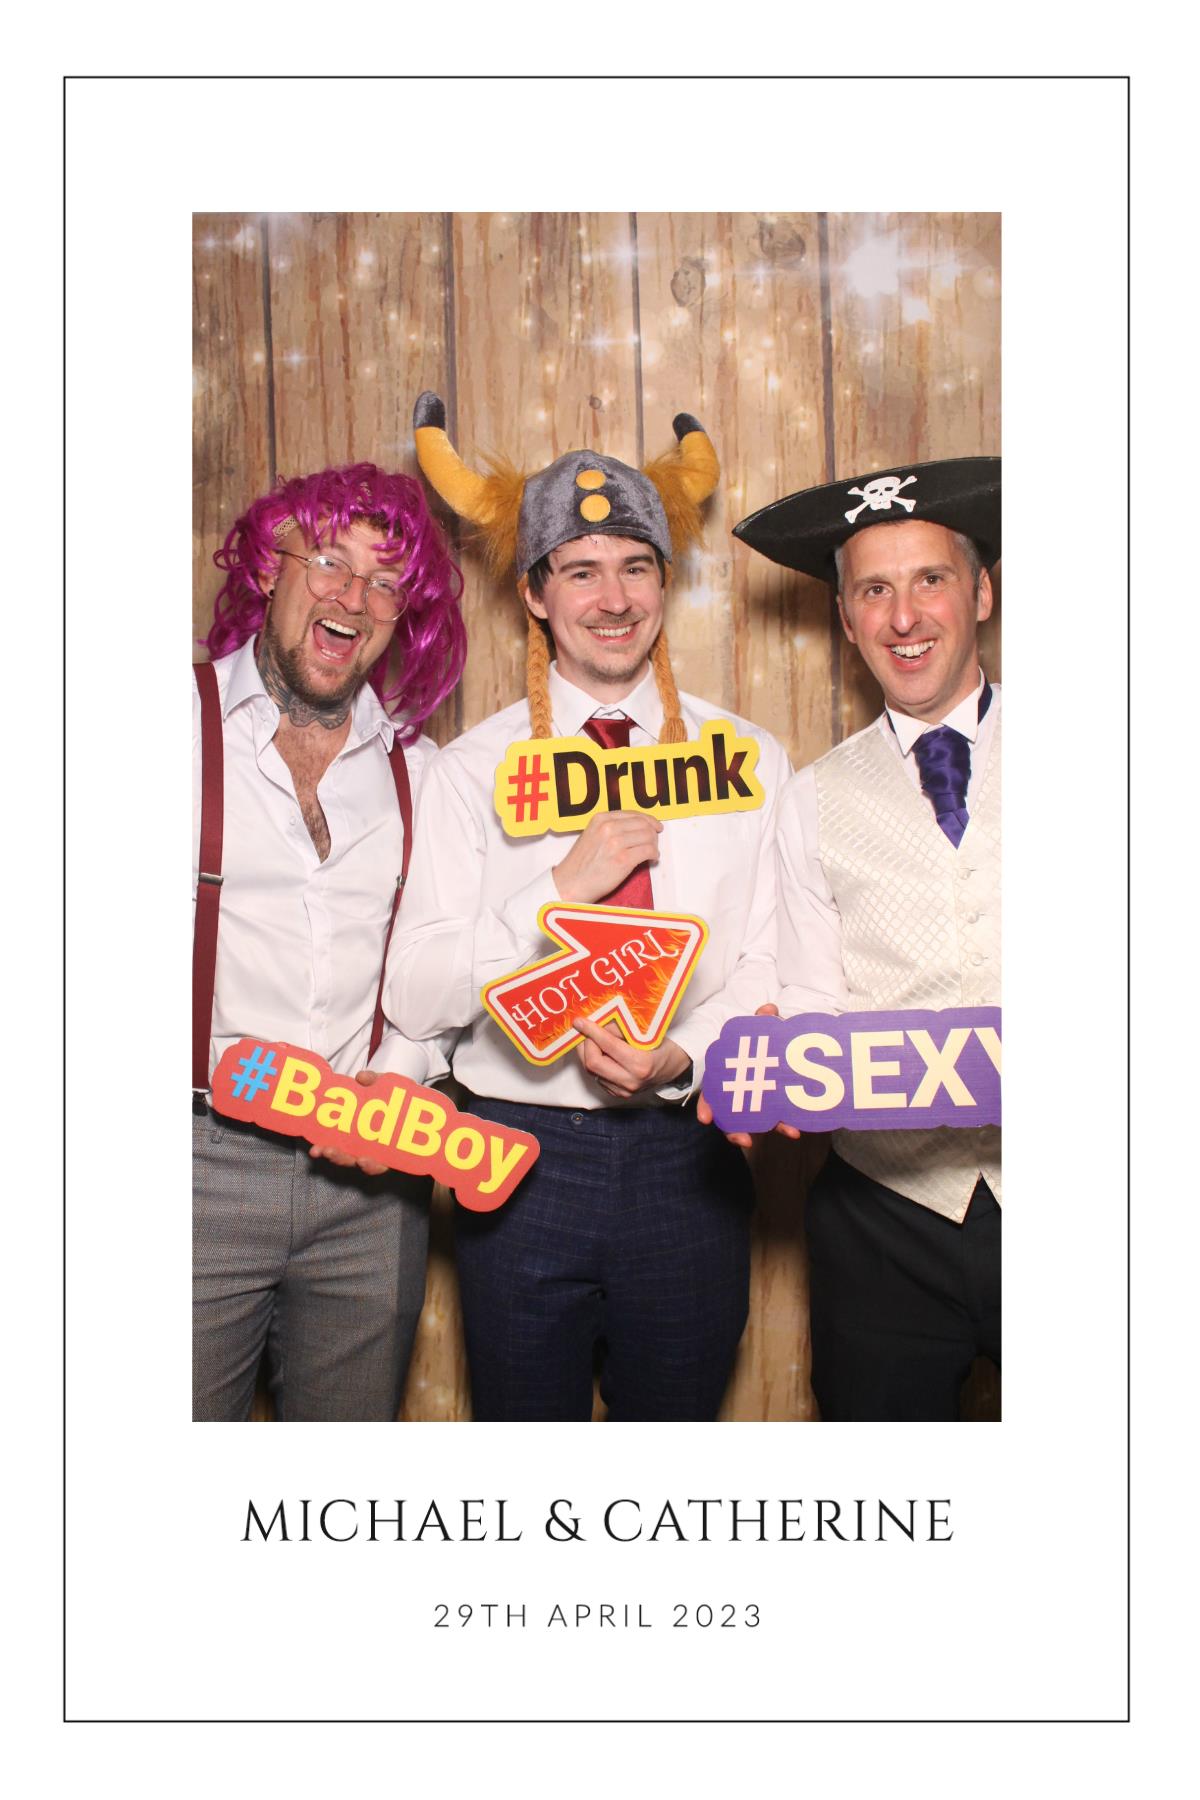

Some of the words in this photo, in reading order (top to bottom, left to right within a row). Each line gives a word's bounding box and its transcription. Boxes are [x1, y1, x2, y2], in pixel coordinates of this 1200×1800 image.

[507, 733, 754, 822] #Drunk
[511, 970, 588, 1030] HOT
[590, 930, 680, 987] GIRL
[230, 1046, 529, 1193] #BadBoy
